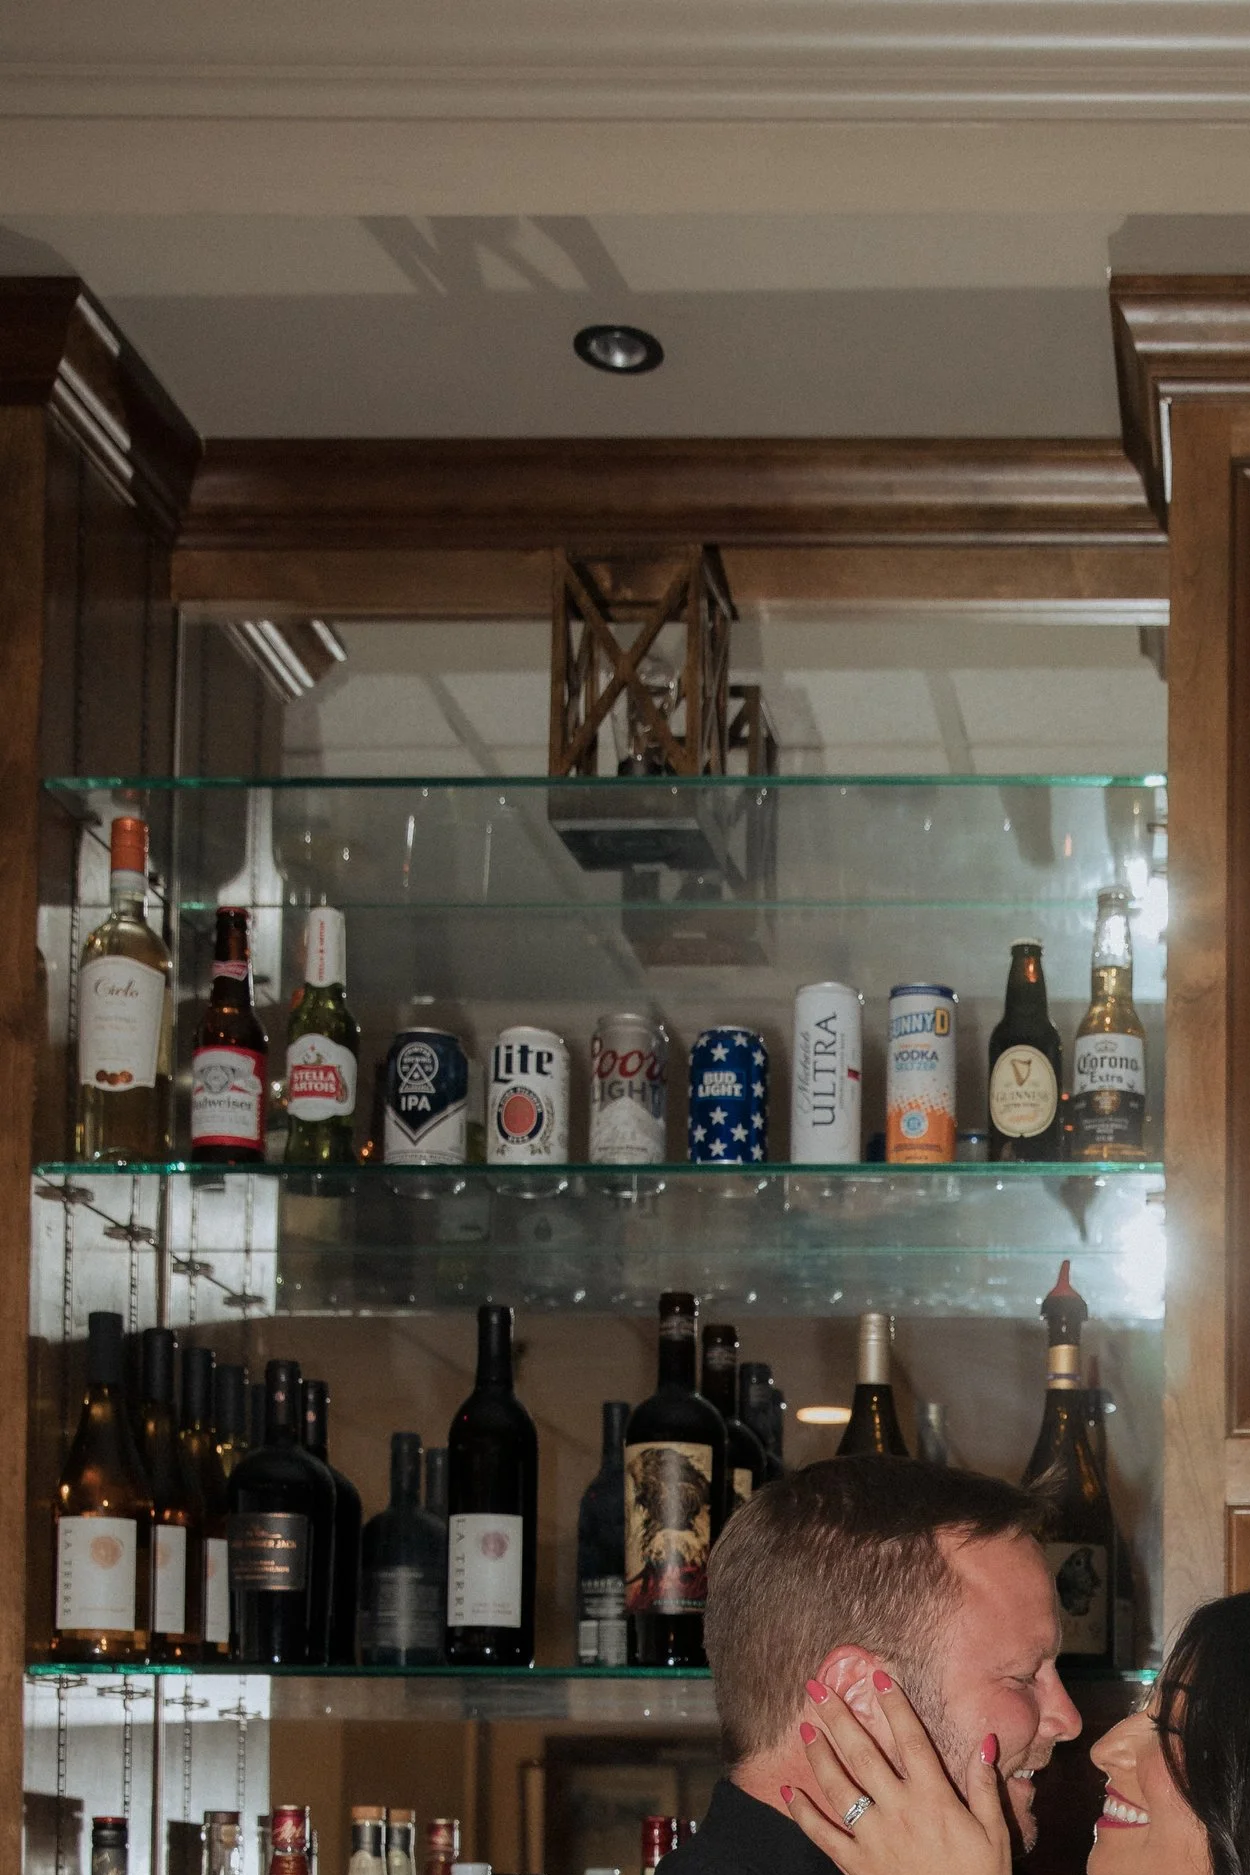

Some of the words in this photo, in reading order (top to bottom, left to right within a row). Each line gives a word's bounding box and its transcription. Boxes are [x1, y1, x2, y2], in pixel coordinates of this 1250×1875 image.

[494, 1044, 554, 1084] Lite
[894, 1050, 939, 1063] VODKA
[1077, 1053, 1140, 1075] Corona
[294, 1070, 336, 1082] STELLA
[813, 1011, 838, 1127] ULTRA
[702, 1070, 738, 1086] BUD
[1089, 1072, 1124, 1084] Extra
[293, 1081, 337, 1093] ARTOIS
[698, 1083, 744, 1098] LIGHT
[400, 1094, 432, 1112] IPA
[455, 1517, 466, 1543] LA
[454, 1553, 466, 1619] TERRE
